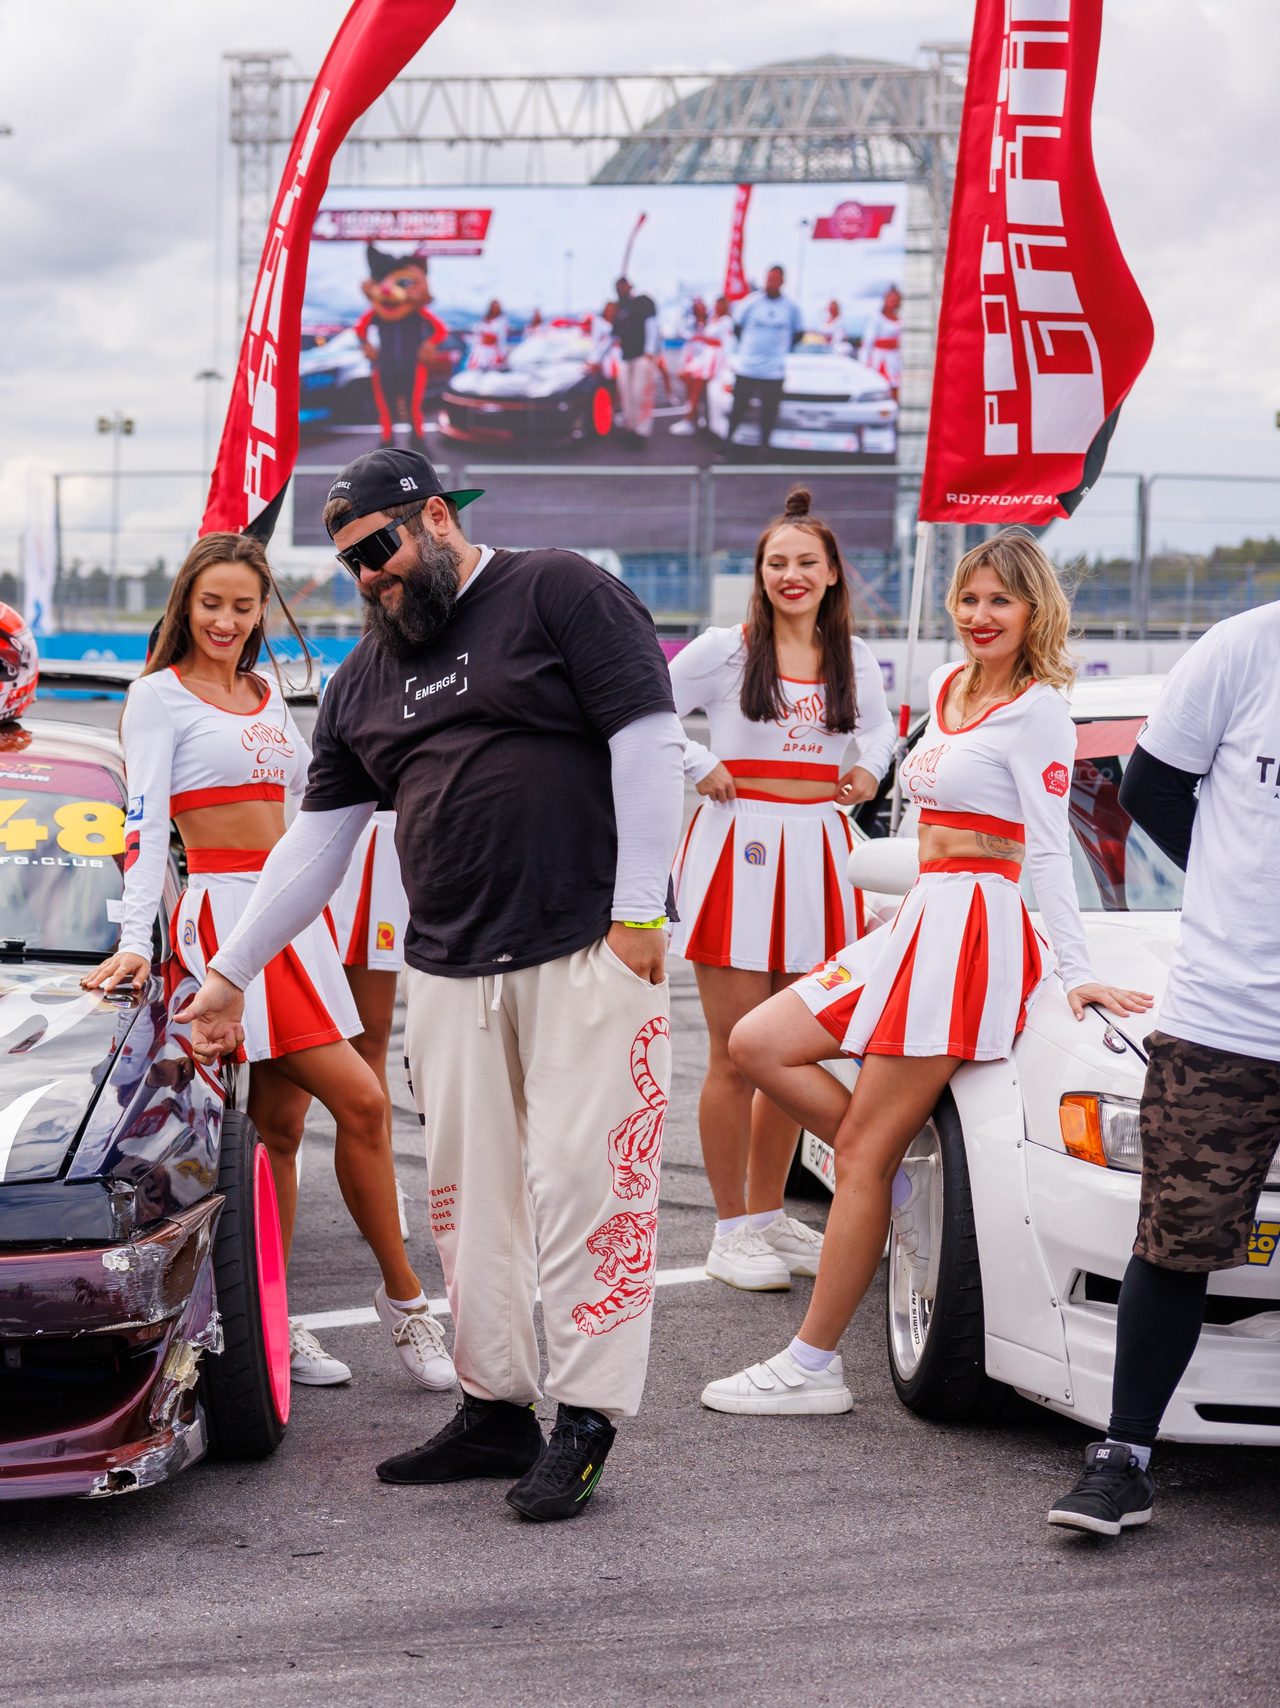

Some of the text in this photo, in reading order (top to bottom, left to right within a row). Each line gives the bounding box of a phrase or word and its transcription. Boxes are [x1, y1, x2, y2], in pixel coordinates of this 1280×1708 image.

[1006, 0, 1106, 455] GARA
[399, 476, 418, 492] 91
[415, 672, 457, 700] EMERGE
[782, 743, 823, 754] ДРАЙВ
[252, 766, 285, 779] ДРАЙВ
[912, 1308, 920, 1345] COSMIS
